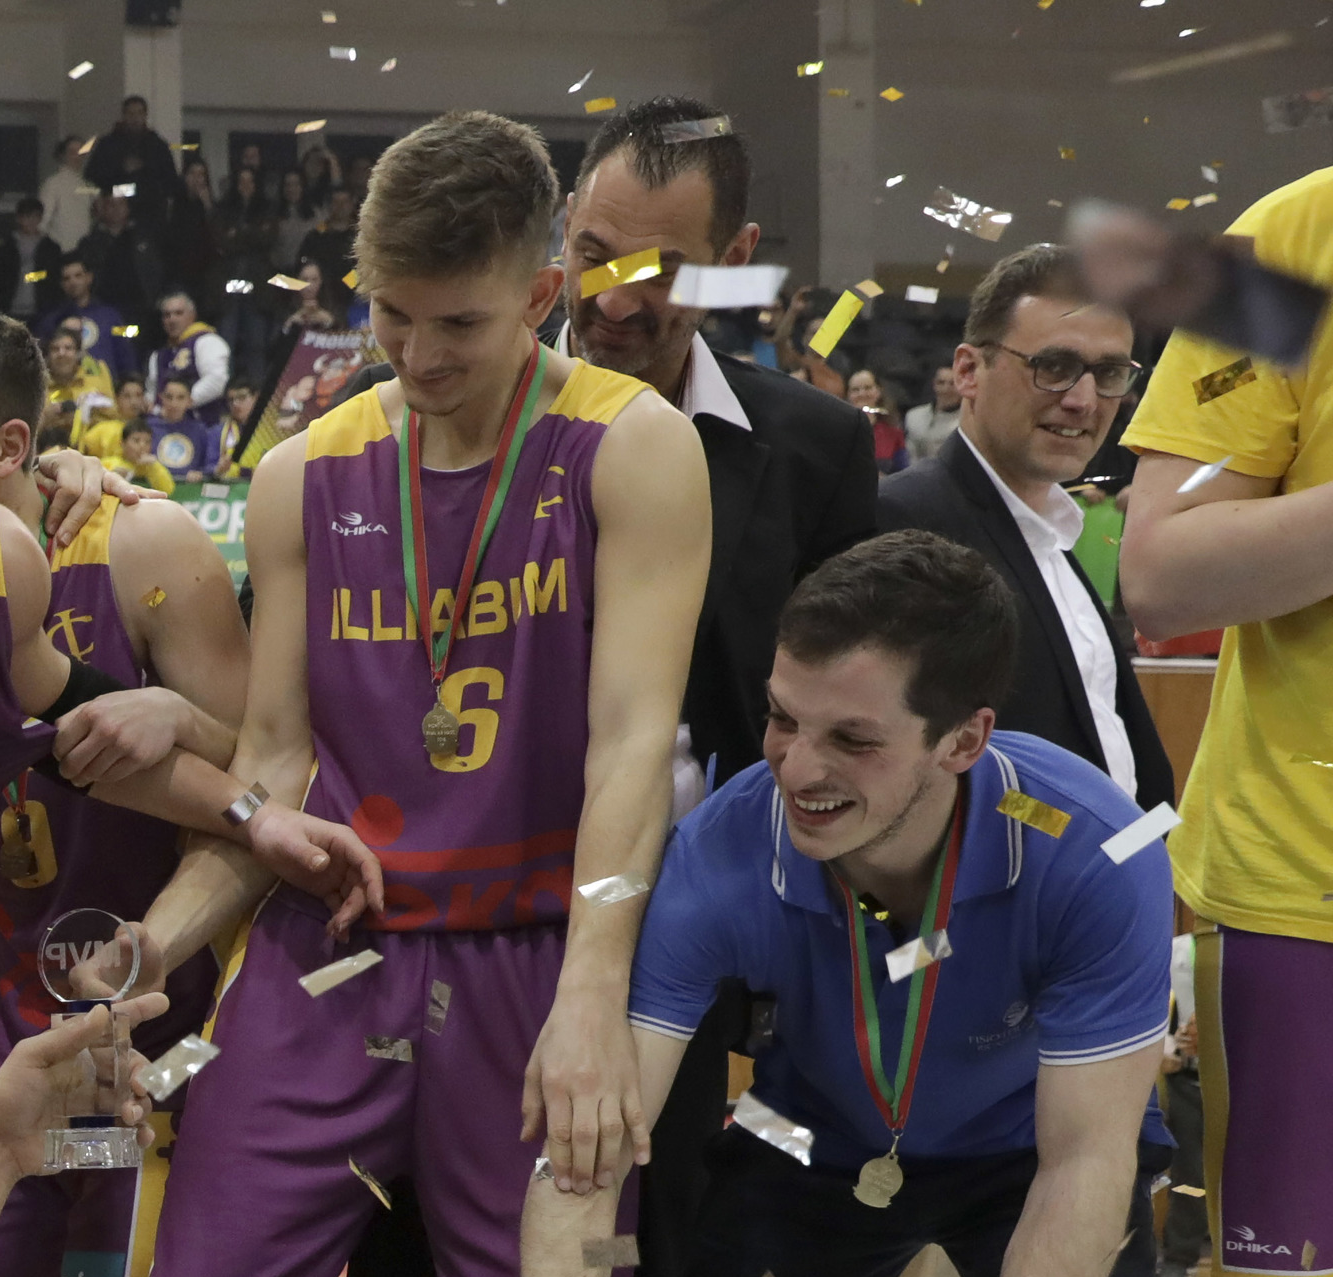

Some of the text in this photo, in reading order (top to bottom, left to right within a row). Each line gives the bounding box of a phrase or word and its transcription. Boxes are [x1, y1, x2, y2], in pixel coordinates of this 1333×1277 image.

[331, 519, 389, 536] DHIKA
[429, 666, 505, 773] 6
[1225, 1241, 1293, 1255] DHIKA
